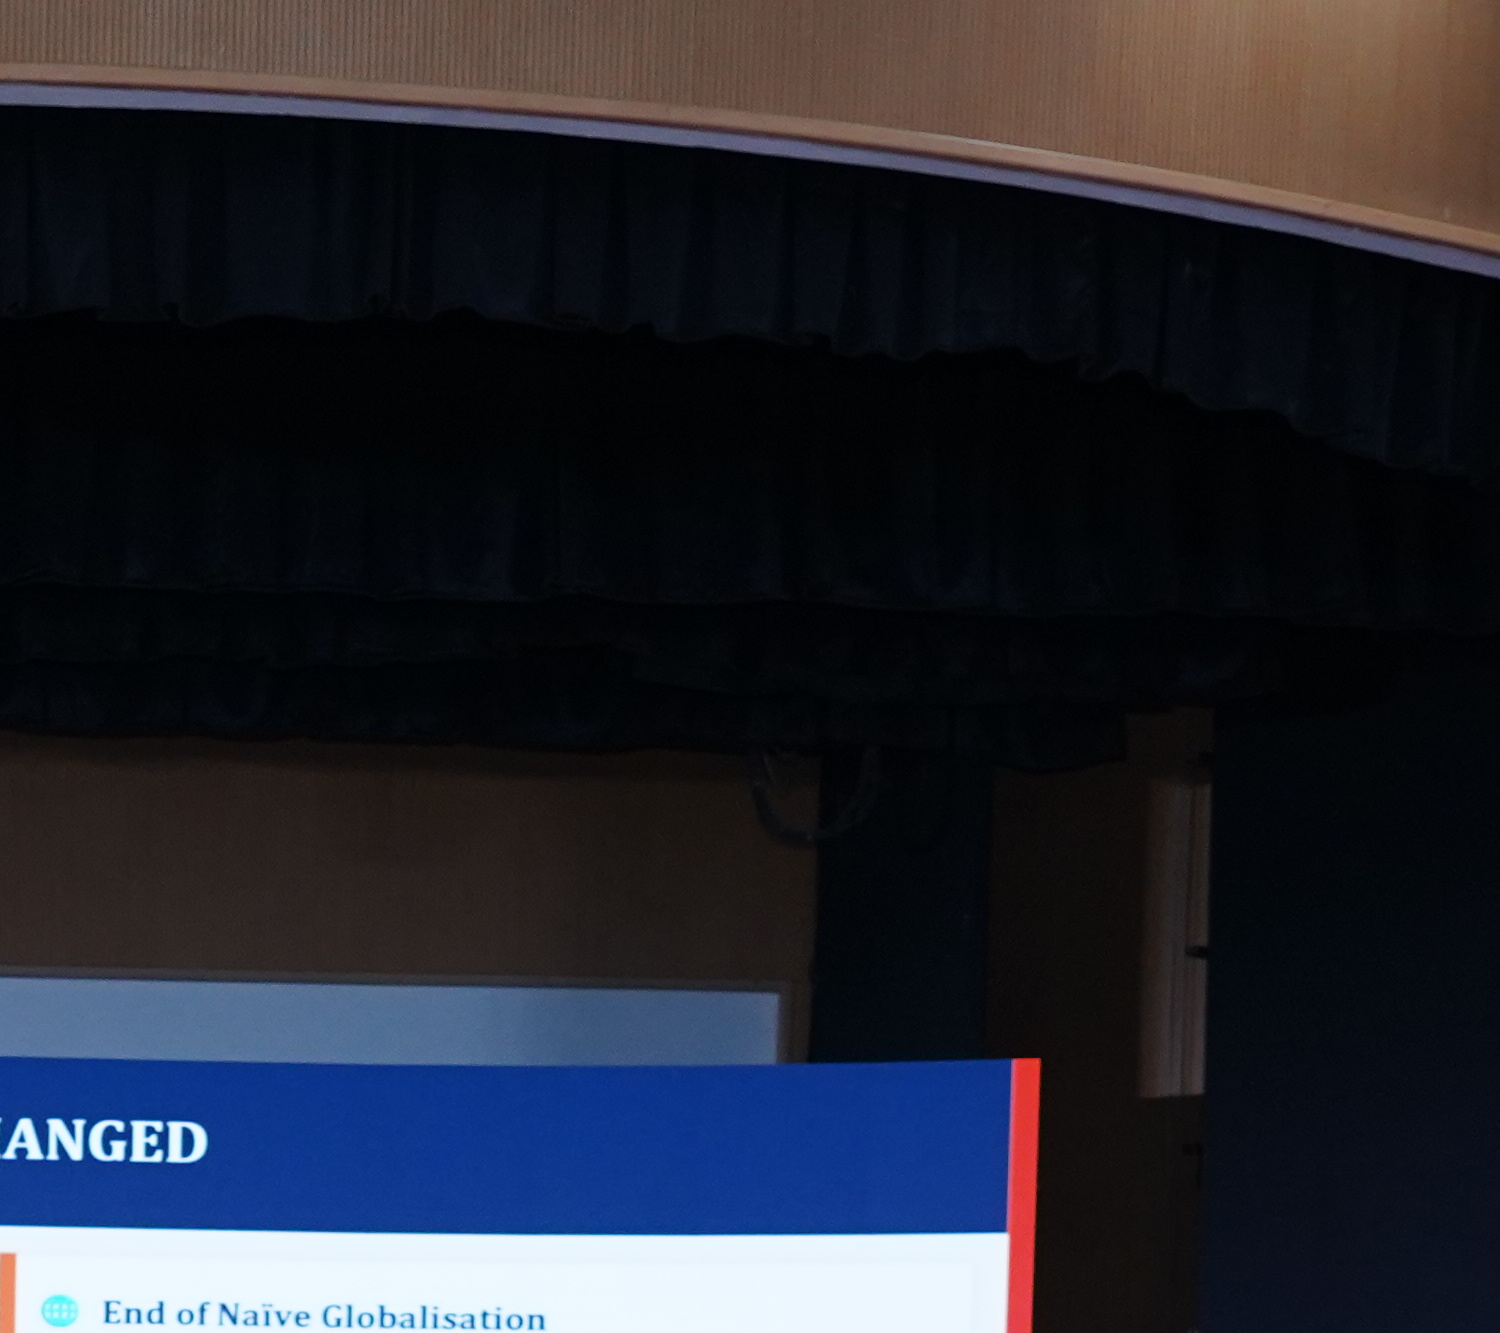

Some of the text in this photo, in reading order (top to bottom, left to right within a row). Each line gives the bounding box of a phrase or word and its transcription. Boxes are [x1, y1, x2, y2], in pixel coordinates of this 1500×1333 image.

[102, 1299, 547, 1332] End of Naïve Globalisation
